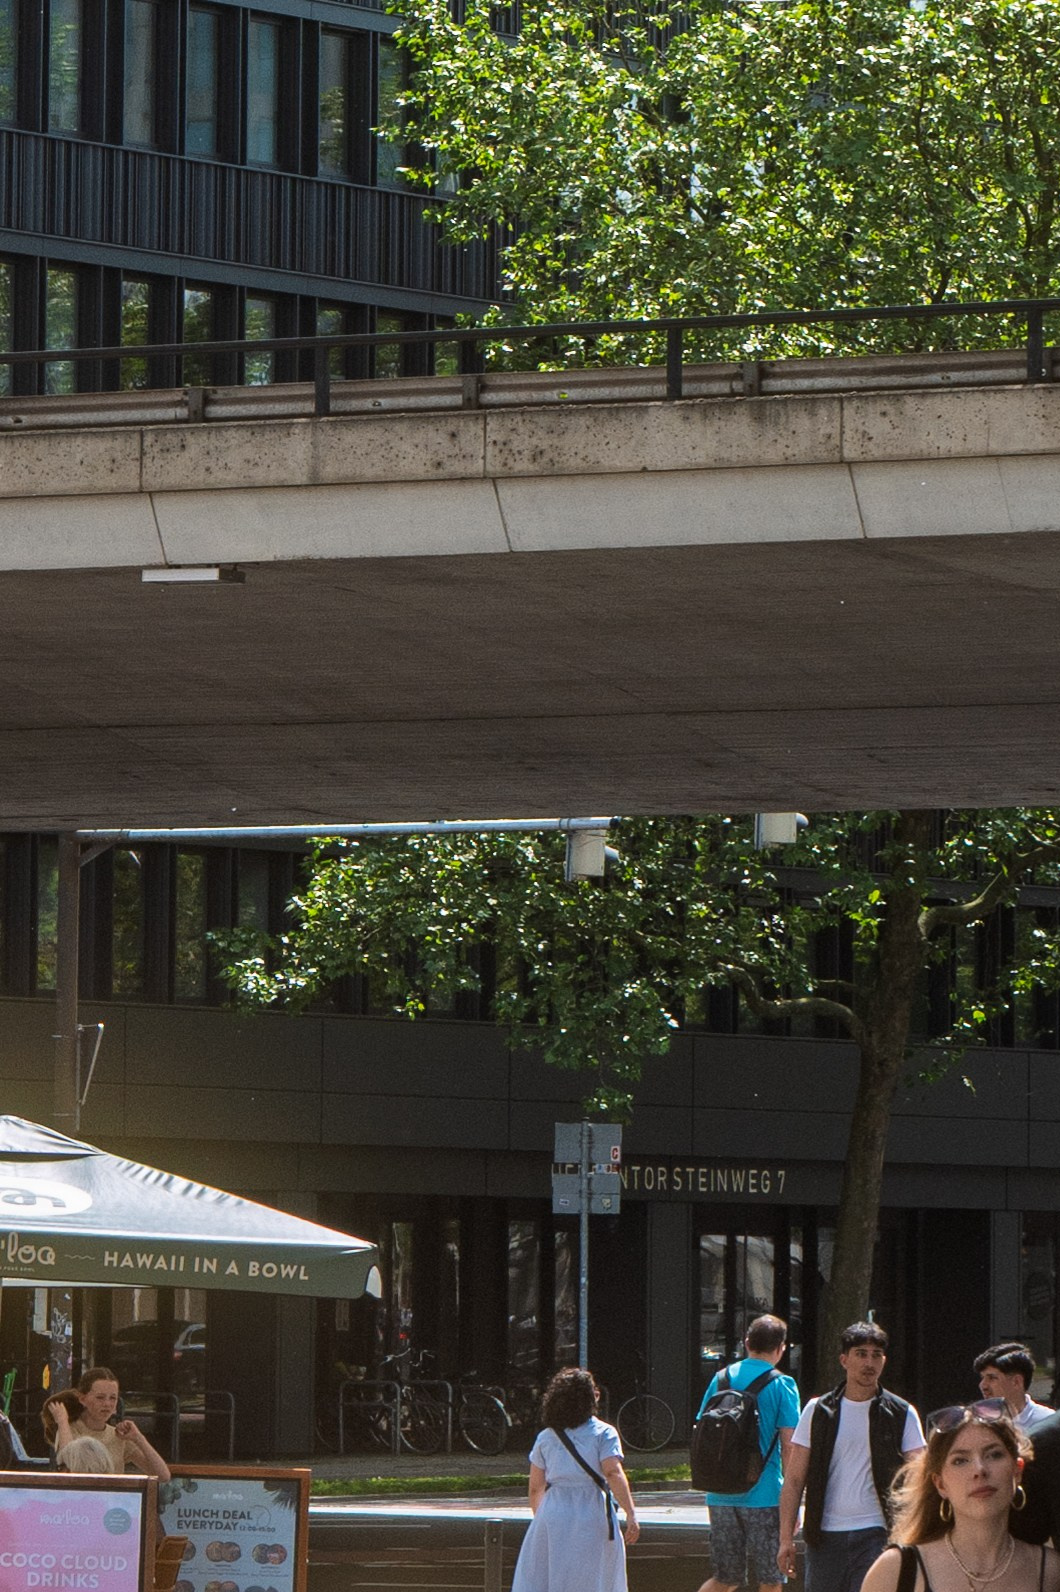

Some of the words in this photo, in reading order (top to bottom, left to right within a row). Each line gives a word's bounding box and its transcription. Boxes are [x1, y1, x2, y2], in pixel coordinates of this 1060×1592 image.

[777, 1170, 786, 1194] 7
[103, 1251, 185, 1272] HAWAII
[194, 1256, 217, 1274] IN
[225, 1259, 240, 1276] A
[248, 1261, 309, 1281] BOWL
[177, 1508, 219, 1519] LUNCH
[222, 1510, 253, 1520] DEAL
[177, 1520, 239, 1531] EVERYDAY
[0, 1552, 56, 1569] COCO
[60, 1554, 128, 1572] CLOUD
[27, 1571, 99, 1589] DRINKS
